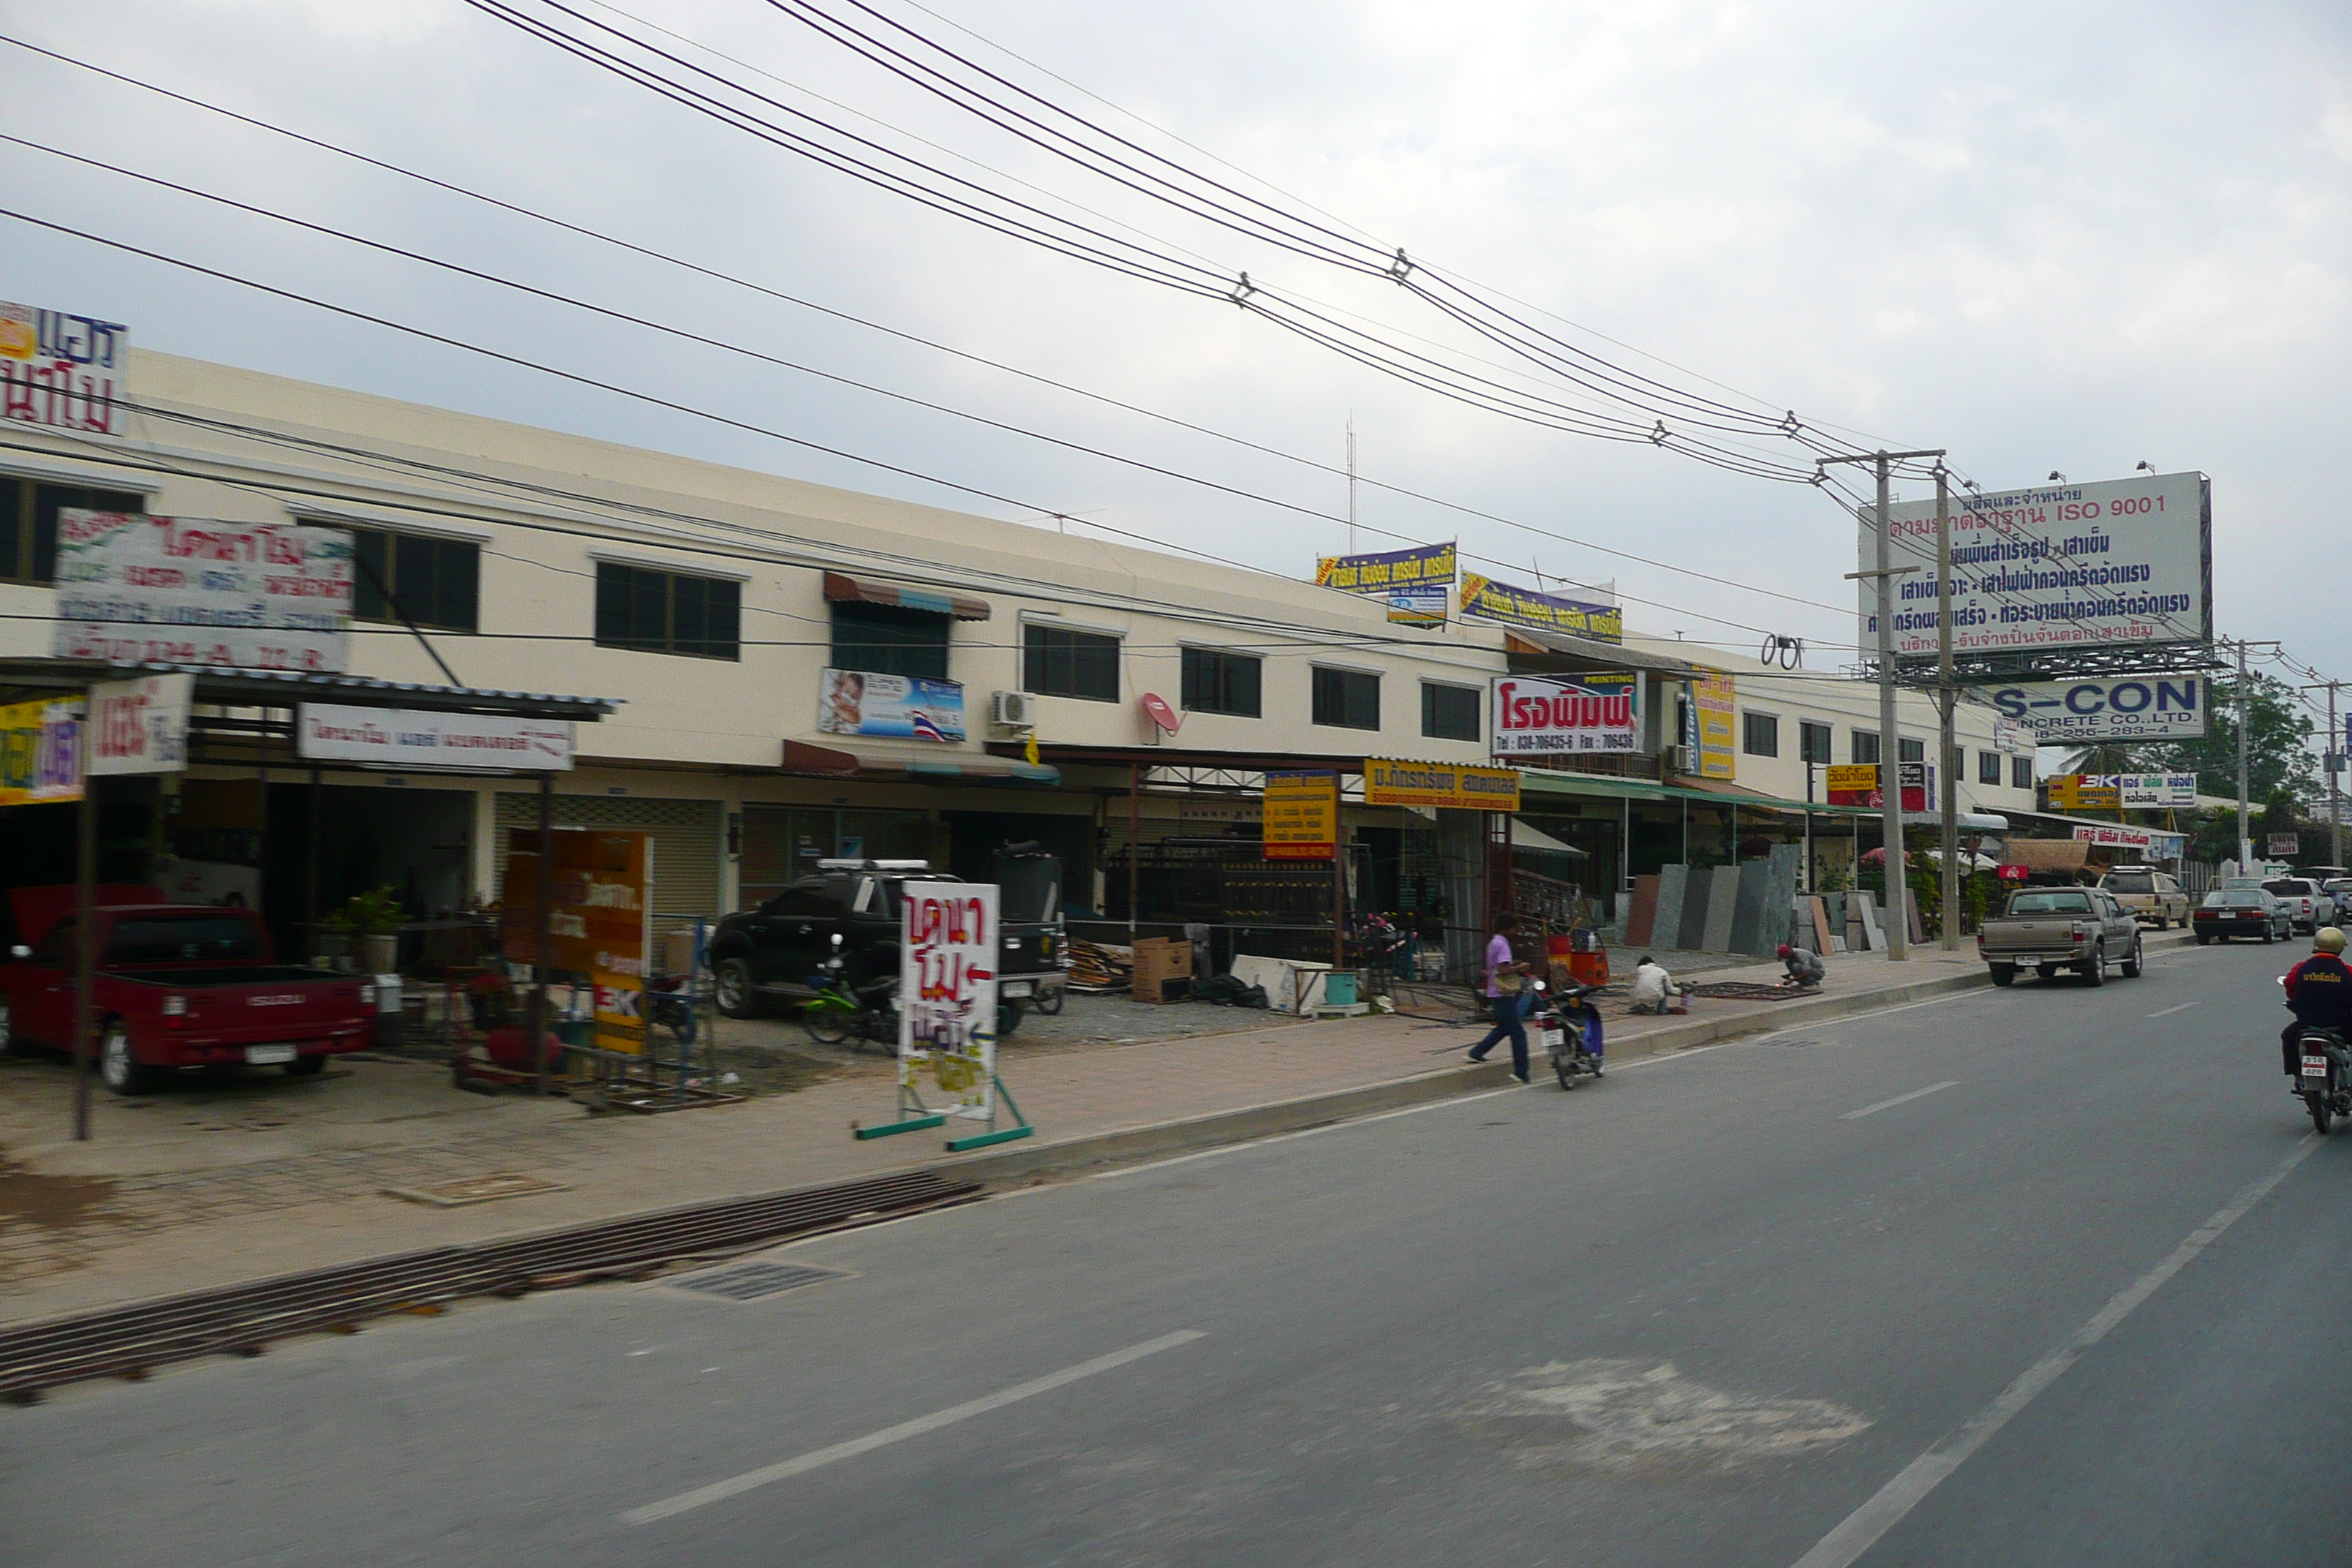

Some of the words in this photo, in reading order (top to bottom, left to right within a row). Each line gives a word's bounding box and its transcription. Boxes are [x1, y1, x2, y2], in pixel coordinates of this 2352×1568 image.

[1963, 488, 2082, 511] ผลิตและจำหน่าย
[2057, 502, 2100, 521] ISO
[2111, 495, 2165, 516] 9001
[2063, 525, 2110, 556] เสาเข็ม
[1584, 674, 1635, 685] PRINTING
[1499, 681, 1635, 731] โรงพิมพ์
[1994, 679, 2196, 719] S-CON
[1497, 736, 1509, 750] Tel
[1580, 734, 1594, 750] Fax
[246, 994, 306, 1006] ISUZU
